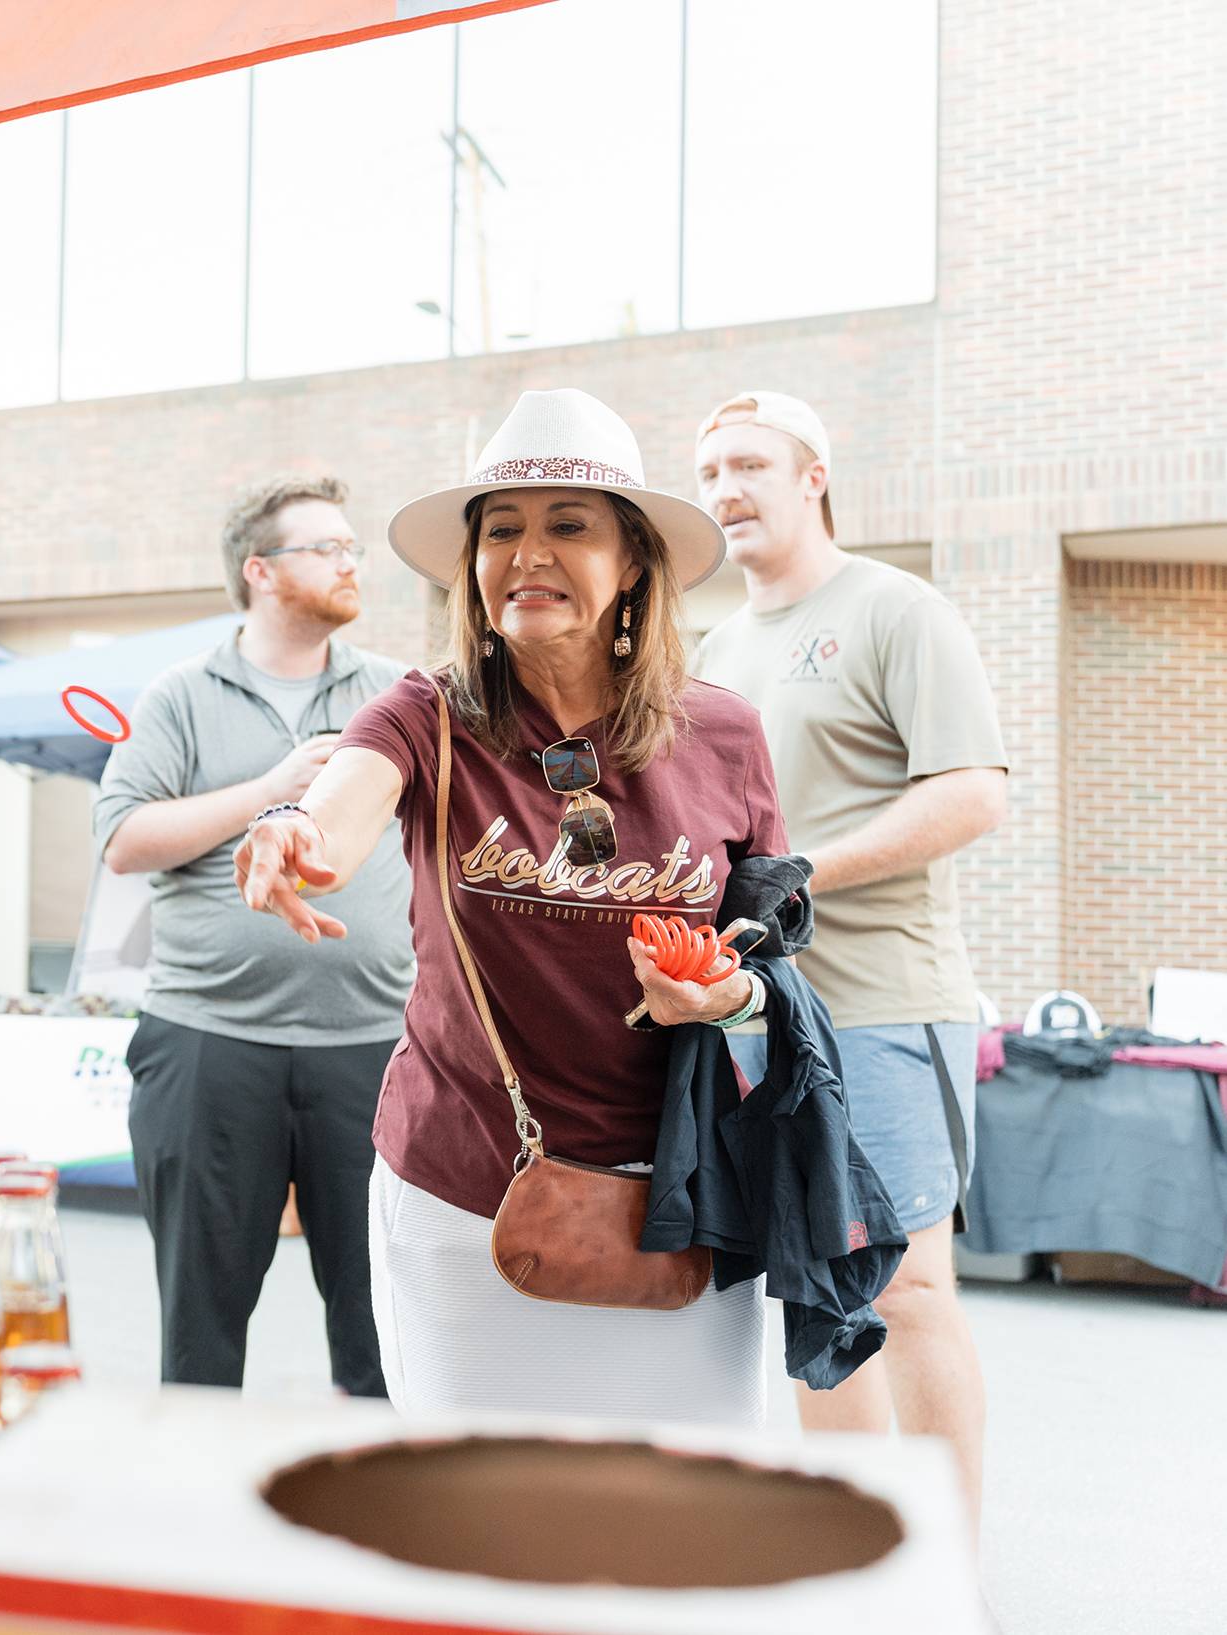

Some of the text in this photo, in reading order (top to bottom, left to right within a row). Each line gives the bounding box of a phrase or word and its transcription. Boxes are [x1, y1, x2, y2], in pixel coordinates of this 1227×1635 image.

[460, 815, 718, 904] bobcats
[491, 899, 535, 915] TEXAS
[544, 906, 587, 921] STATE
